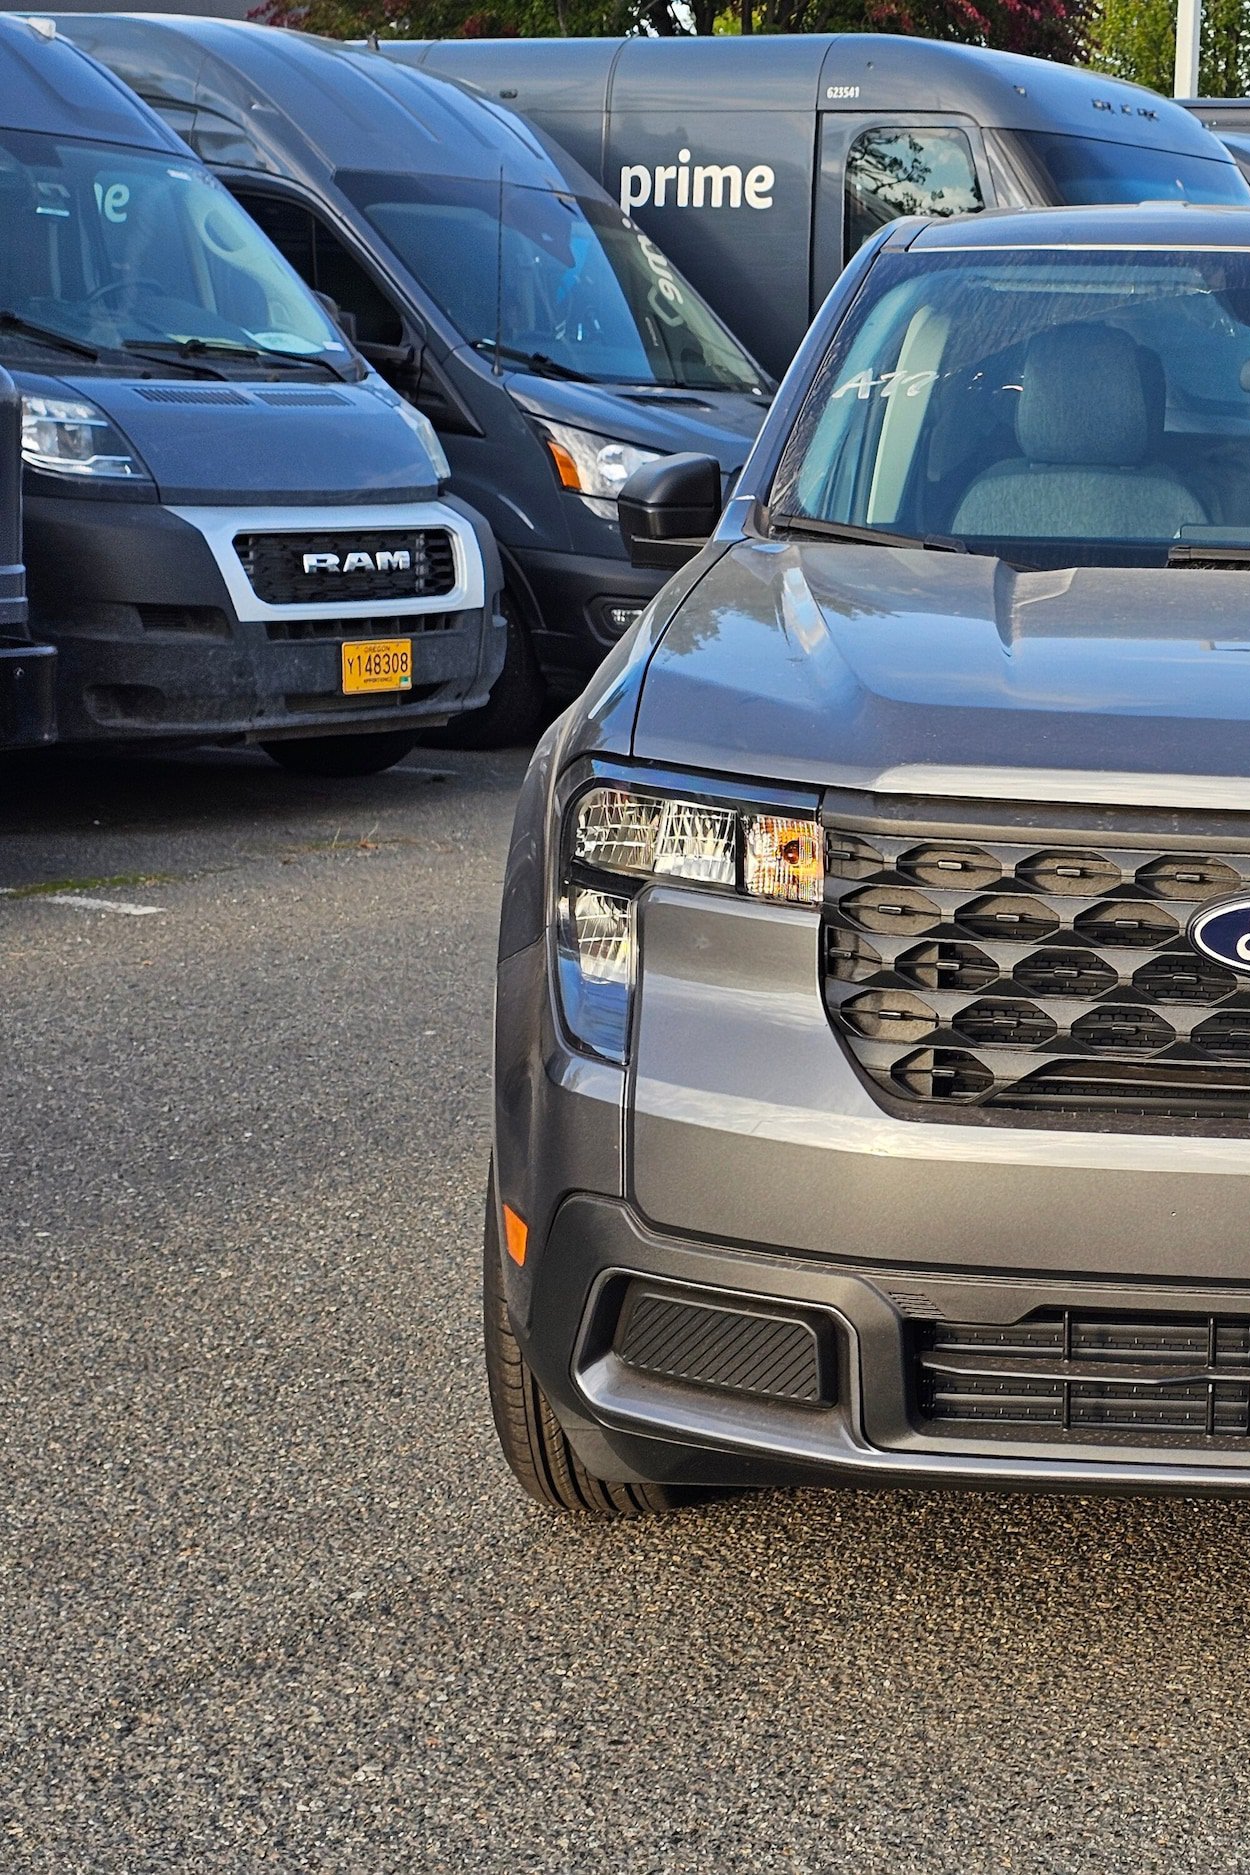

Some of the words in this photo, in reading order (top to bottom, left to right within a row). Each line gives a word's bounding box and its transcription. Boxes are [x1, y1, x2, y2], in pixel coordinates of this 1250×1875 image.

[826, 86, 860, 99] 623541
[620, 148, 775, 217] prime
[302, 550, 411, 574] RAM
[347, 652, 408, 677] Y148308
